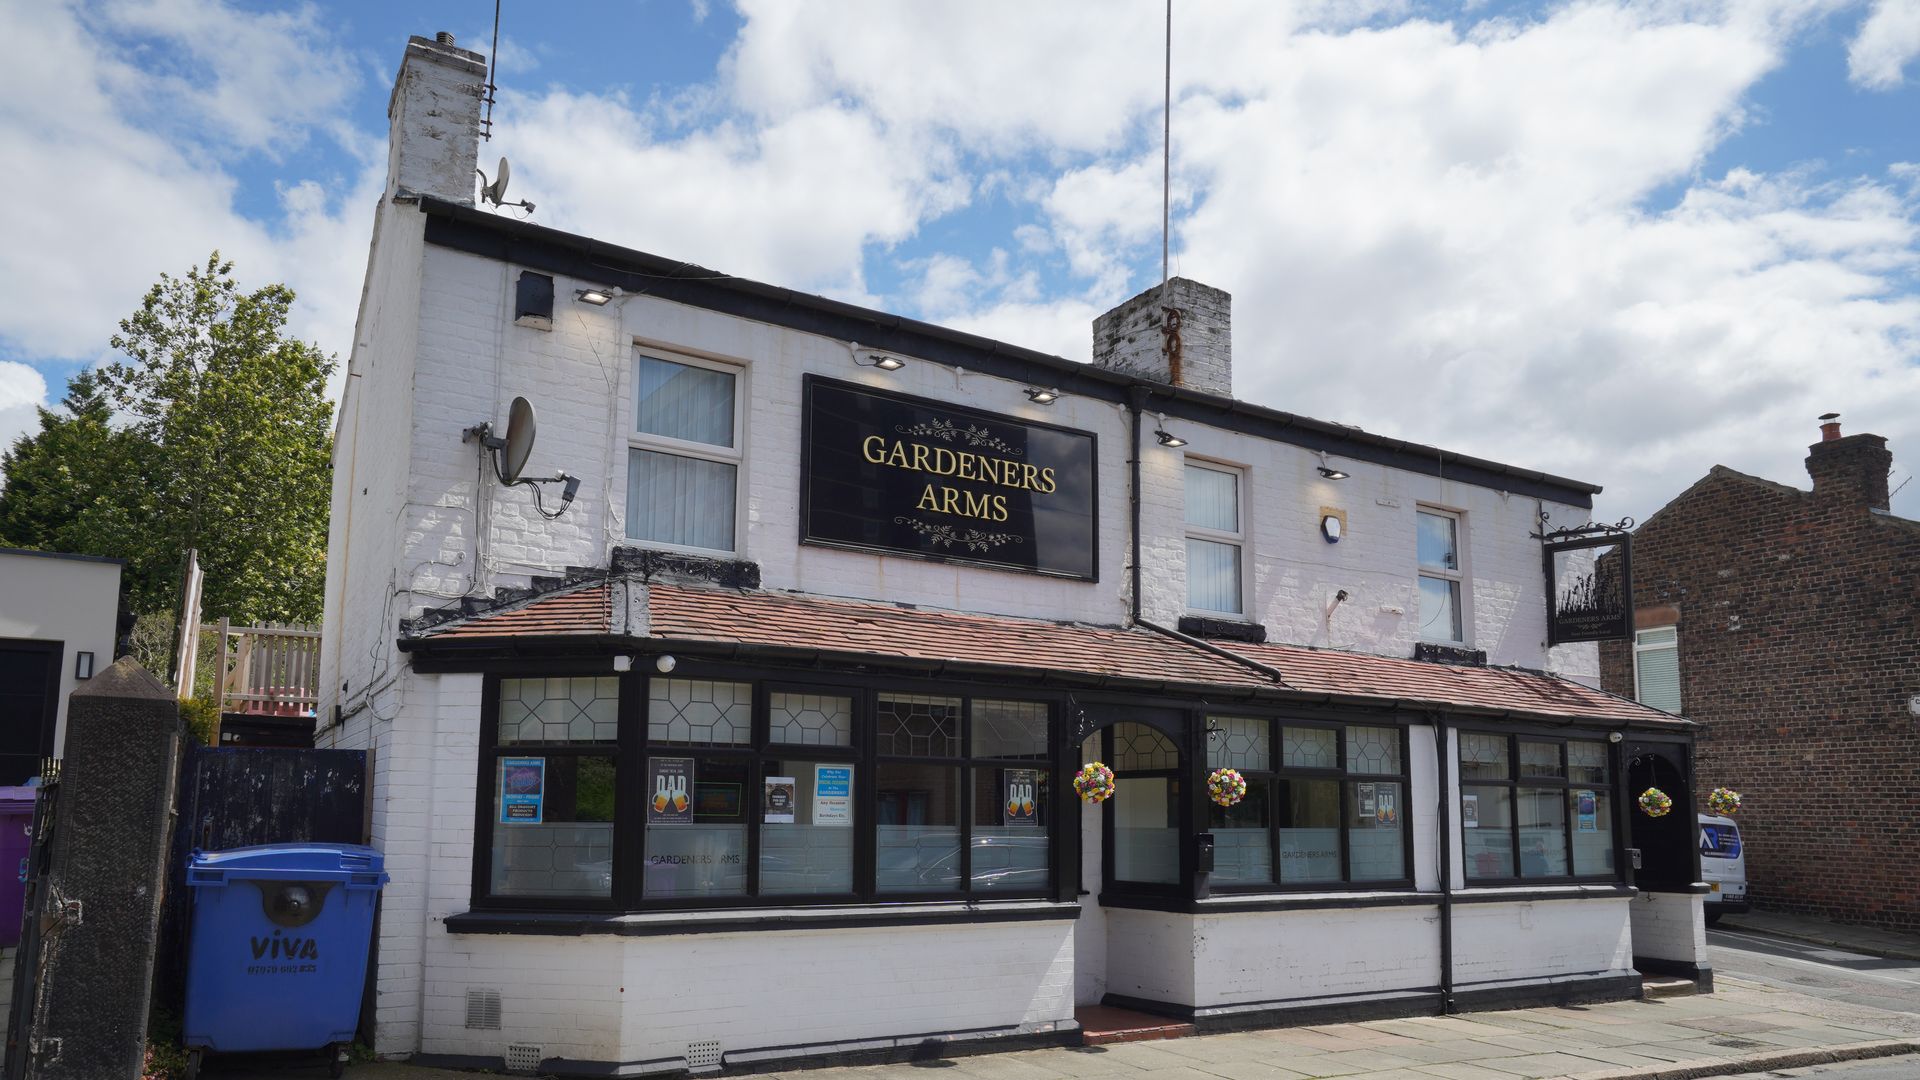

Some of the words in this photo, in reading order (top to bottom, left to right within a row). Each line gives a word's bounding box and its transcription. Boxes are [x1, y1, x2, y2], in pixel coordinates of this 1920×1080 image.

[863, 435, 1057, 493] GARDENERS
[916, 483, 1009, 522] ARMS
[1558, 616, 1600, 625] GARDENERS
[656, 775, 687, 794] DAD
[1010, 784, 1032, 800] DAD
[1379, 795, 1393, 808] DAD
[651, 855, 712, 865] GARDENERS
[714, 854, 741, 864] RMS
